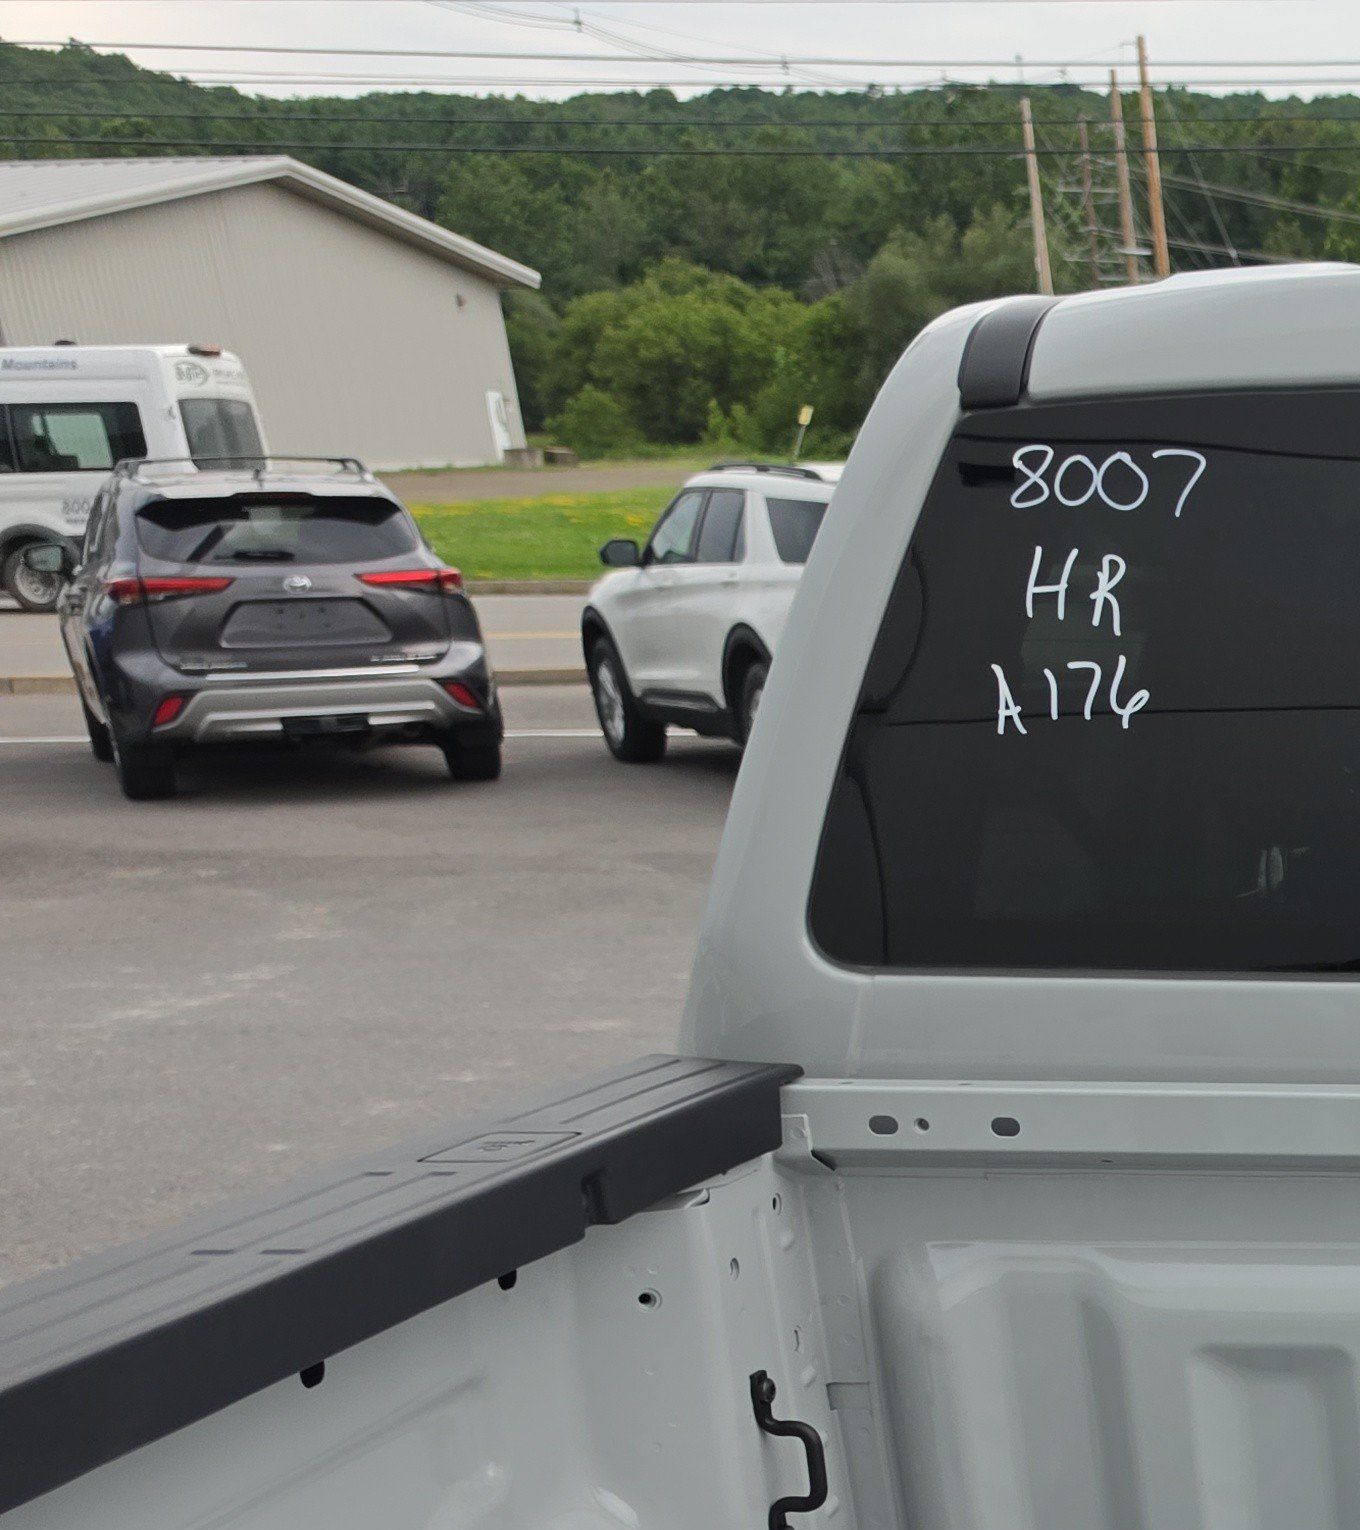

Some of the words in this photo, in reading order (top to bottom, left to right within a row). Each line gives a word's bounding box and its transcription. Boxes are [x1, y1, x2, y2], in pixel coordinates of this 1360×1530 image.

[1, 357, 78, 371] Mountains
[1010, 445, 1207, 517] 8007
[991, 655, 1150, 735] A176
